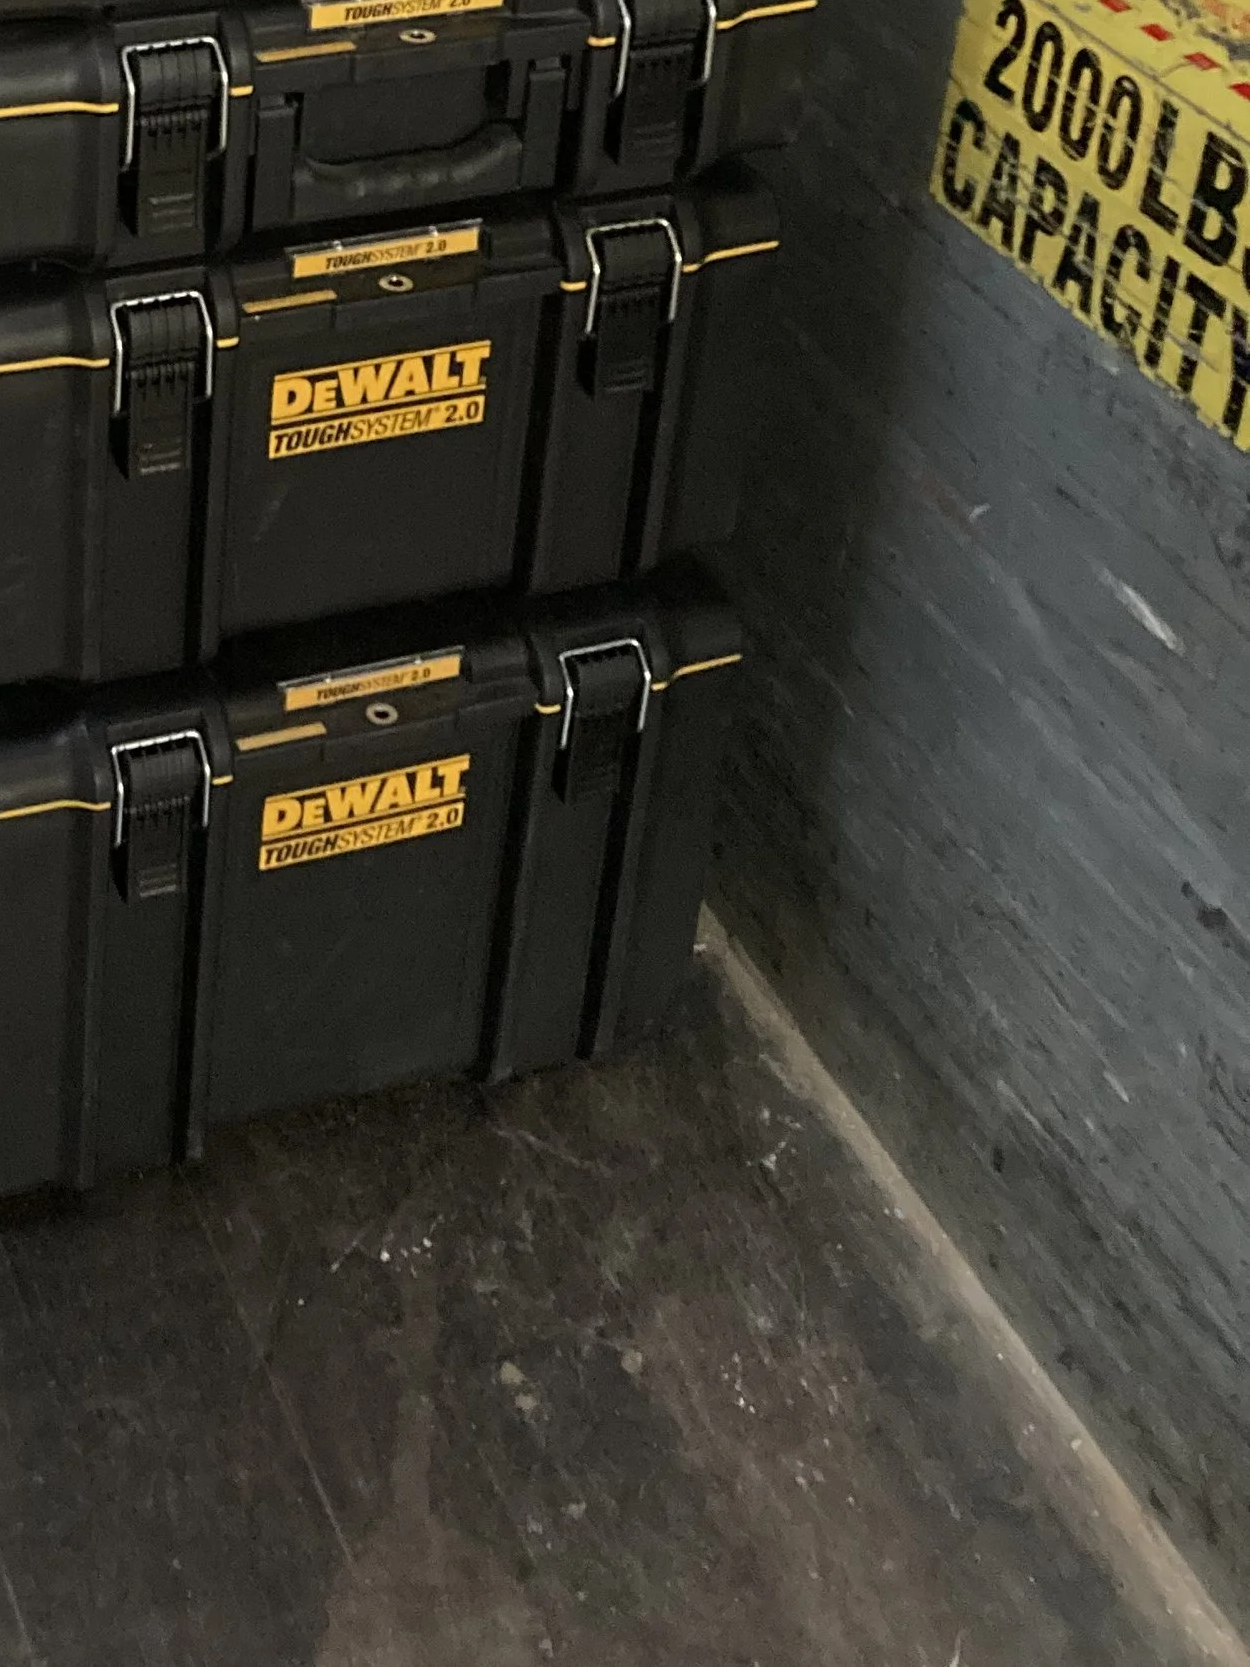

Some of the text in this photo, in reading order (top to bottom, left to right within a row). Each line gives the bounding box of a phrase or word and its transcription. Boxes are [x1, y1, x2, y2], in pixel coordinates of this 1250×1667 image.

[1139, 99, 1250, 292] LB
[426, 240, 447, 254] 2.0
[445, 401, 480, 424] 2.0
[427, 807, 459, 831] 2.0
